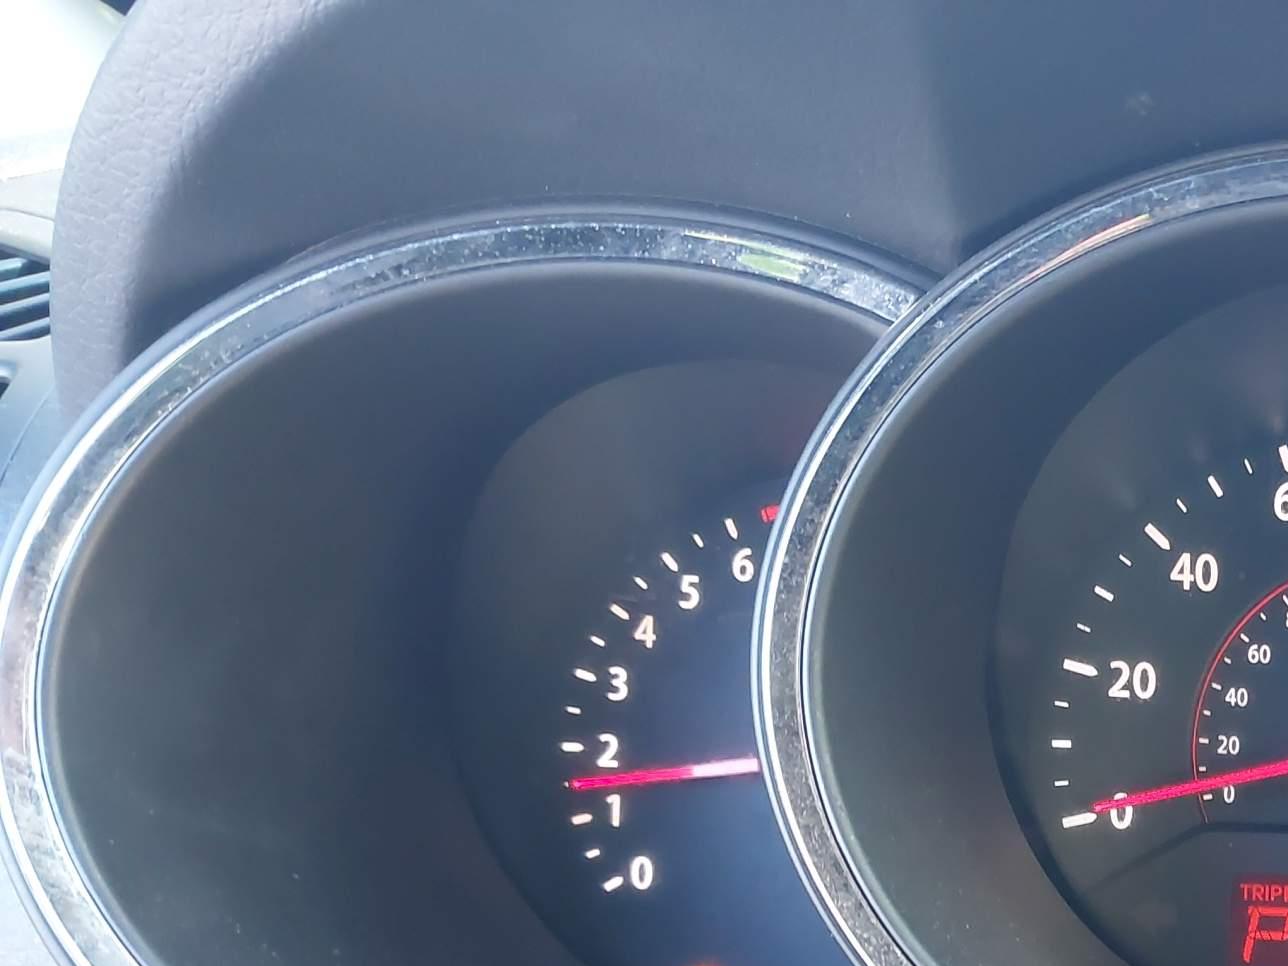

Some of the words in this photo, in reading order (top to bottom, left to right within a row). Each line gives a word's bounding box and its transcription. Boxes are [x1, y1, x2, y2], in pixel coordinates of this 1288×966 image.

[730, 547, 755, 582] 6
[1169, 553, 1219, 592] 40
[678, 574, 700, 609] 5
[634, 615, 656, 648] 4
[1247, 643, 1271, 665] 60
[606, 666, 629, 701] 3
[1107, 661, 1157, 699] 20
[1224, 687, 1249, 708] 40
[596, 733, 619, 768] 2
[1216, 735, 1240, 755] 20
[607, 794, 622, 827] 1
[1109, 792, 1134, 830] 0
[1223, 785, 1235, 803] 0
[630, 855, 653, 890] 0
[1240, 883, 1283, 902] TRIP
